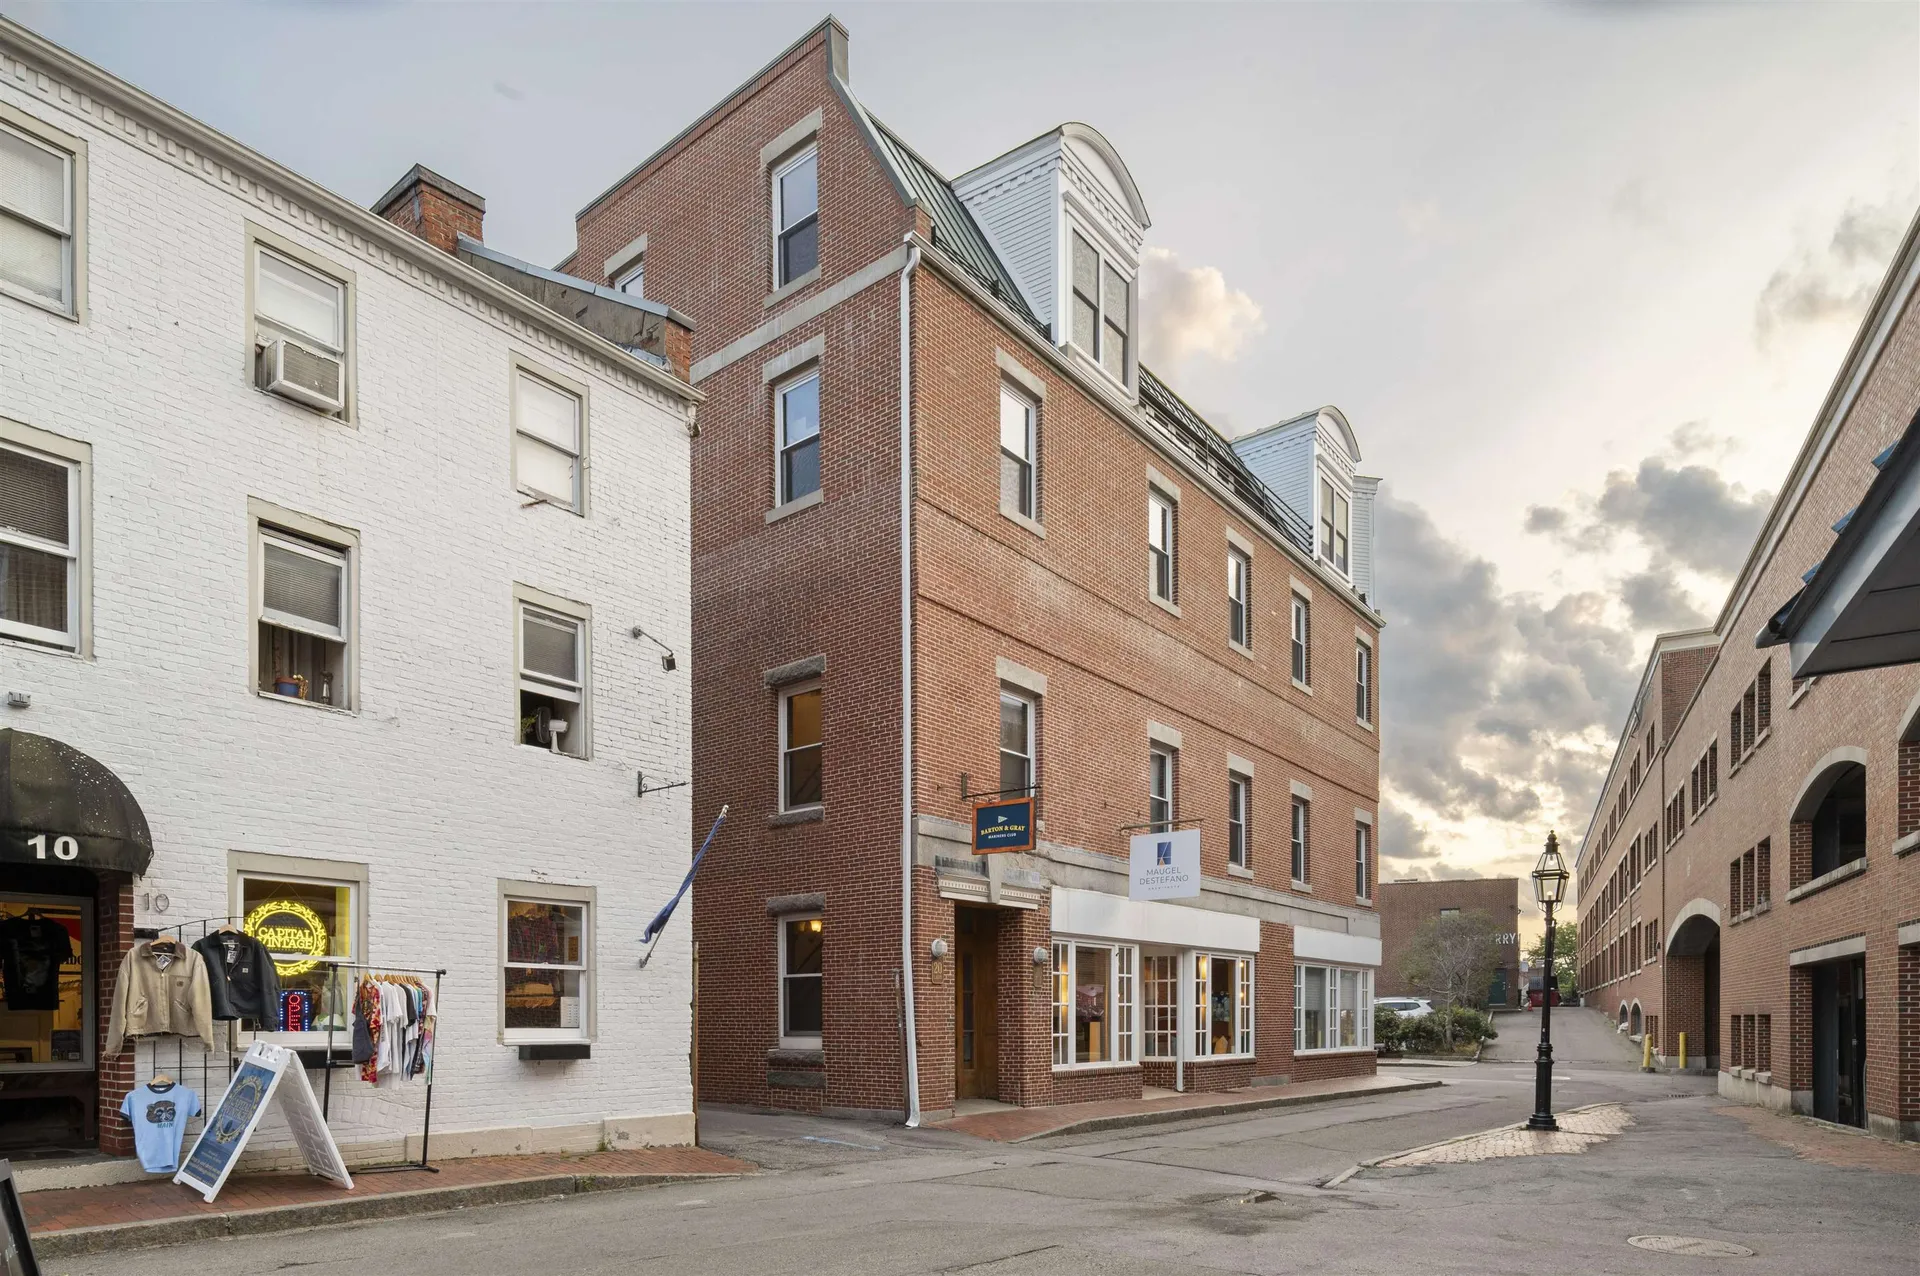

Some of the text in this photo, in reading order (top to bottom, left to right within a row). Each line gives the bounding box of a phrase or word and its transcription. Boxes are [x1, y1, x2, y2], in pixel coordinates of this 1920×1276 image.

[981, 825, 1003, 836] BARTON
[27, 834, 79, 861] 10
[1146, 866, 1181, 876] MAUGEL
[1140, 874, 1189, 885] DESTEFANO
[143, 892, 170, 914] 10
[258, 927, 313, 940] CAPITAL
[256, 936, 313, 949] VINTAGE
[289, 994, 301, 1032] OPEN
